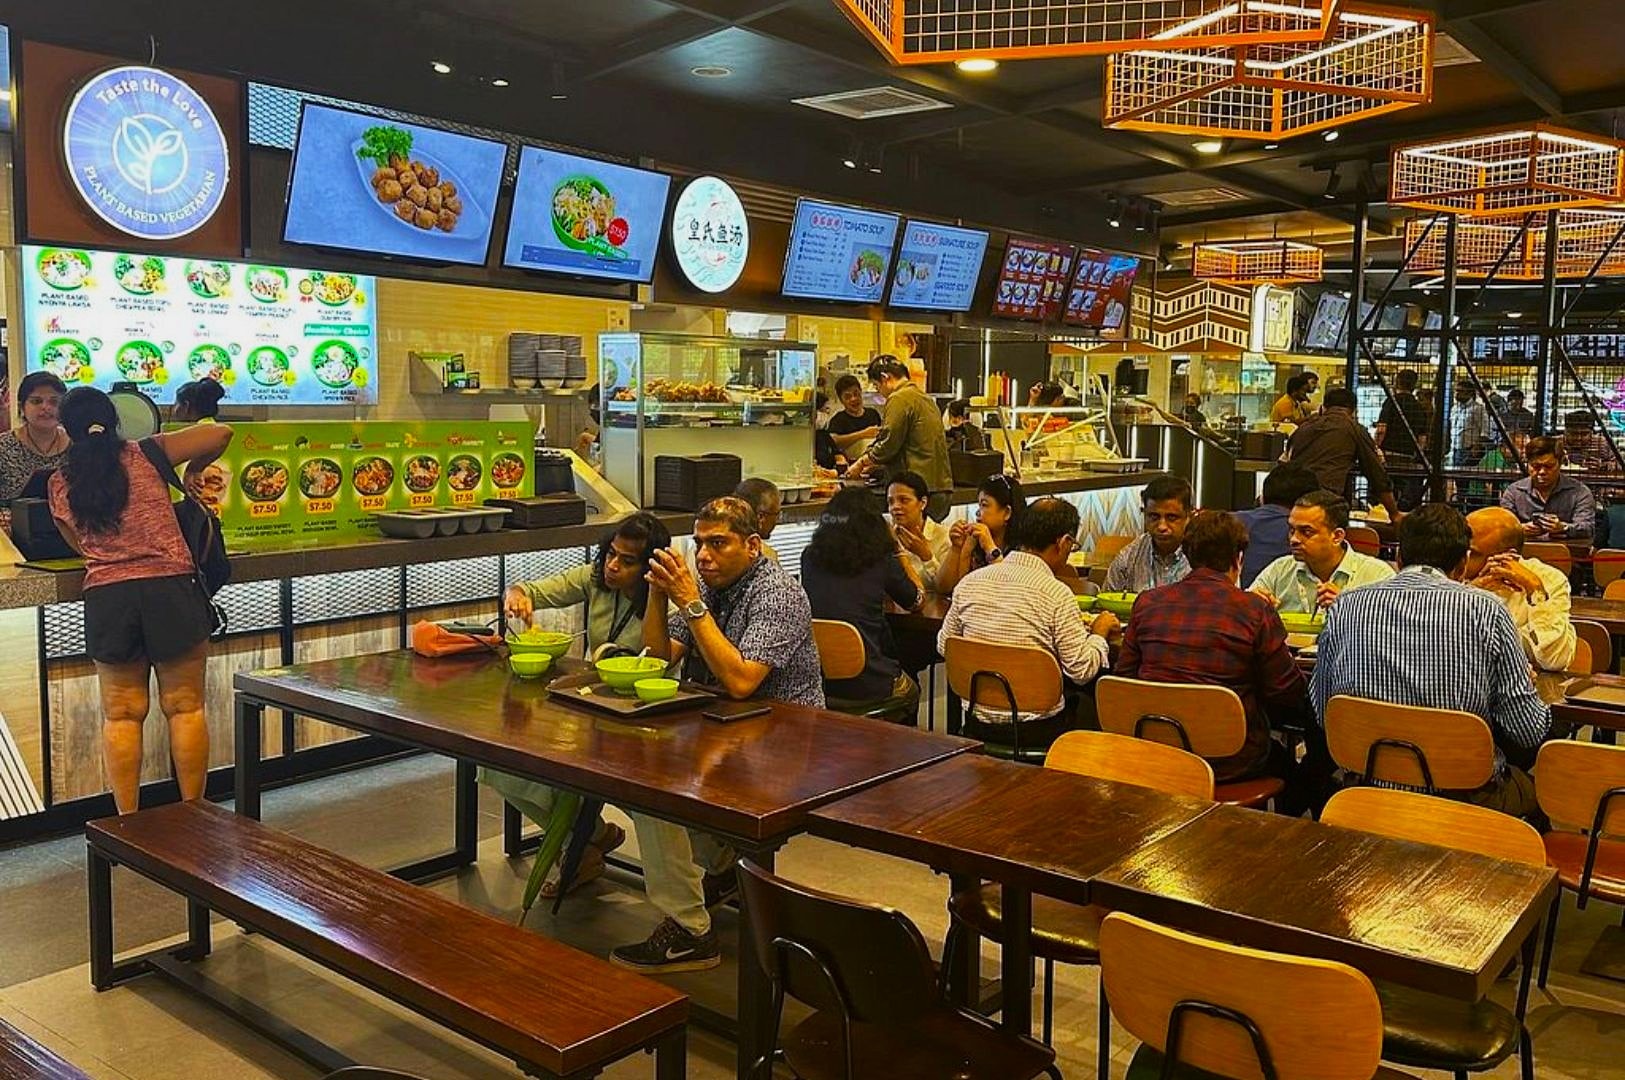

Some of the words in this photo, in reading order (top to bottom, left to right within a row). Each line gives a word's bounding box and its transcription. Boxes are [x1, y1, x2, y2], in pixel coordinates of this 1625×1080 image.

[96, 80, 139, 106] Taste
[142, 78, 170, 97] the
[172, 91, 203, 129] Love
[84, 165, 118, 206] PLANT
[116, 203, 158, 224] BASED
[159, 170, 216, 223] VEGETARIAN
[412, 496, 432, 505] $7.50
[455, 493, 474, 502] $7.50
[309, 502, 333, 512] $7.50
[362, 498, 385, 508] $7.50
[253, 505, 277, 514] $7.50
